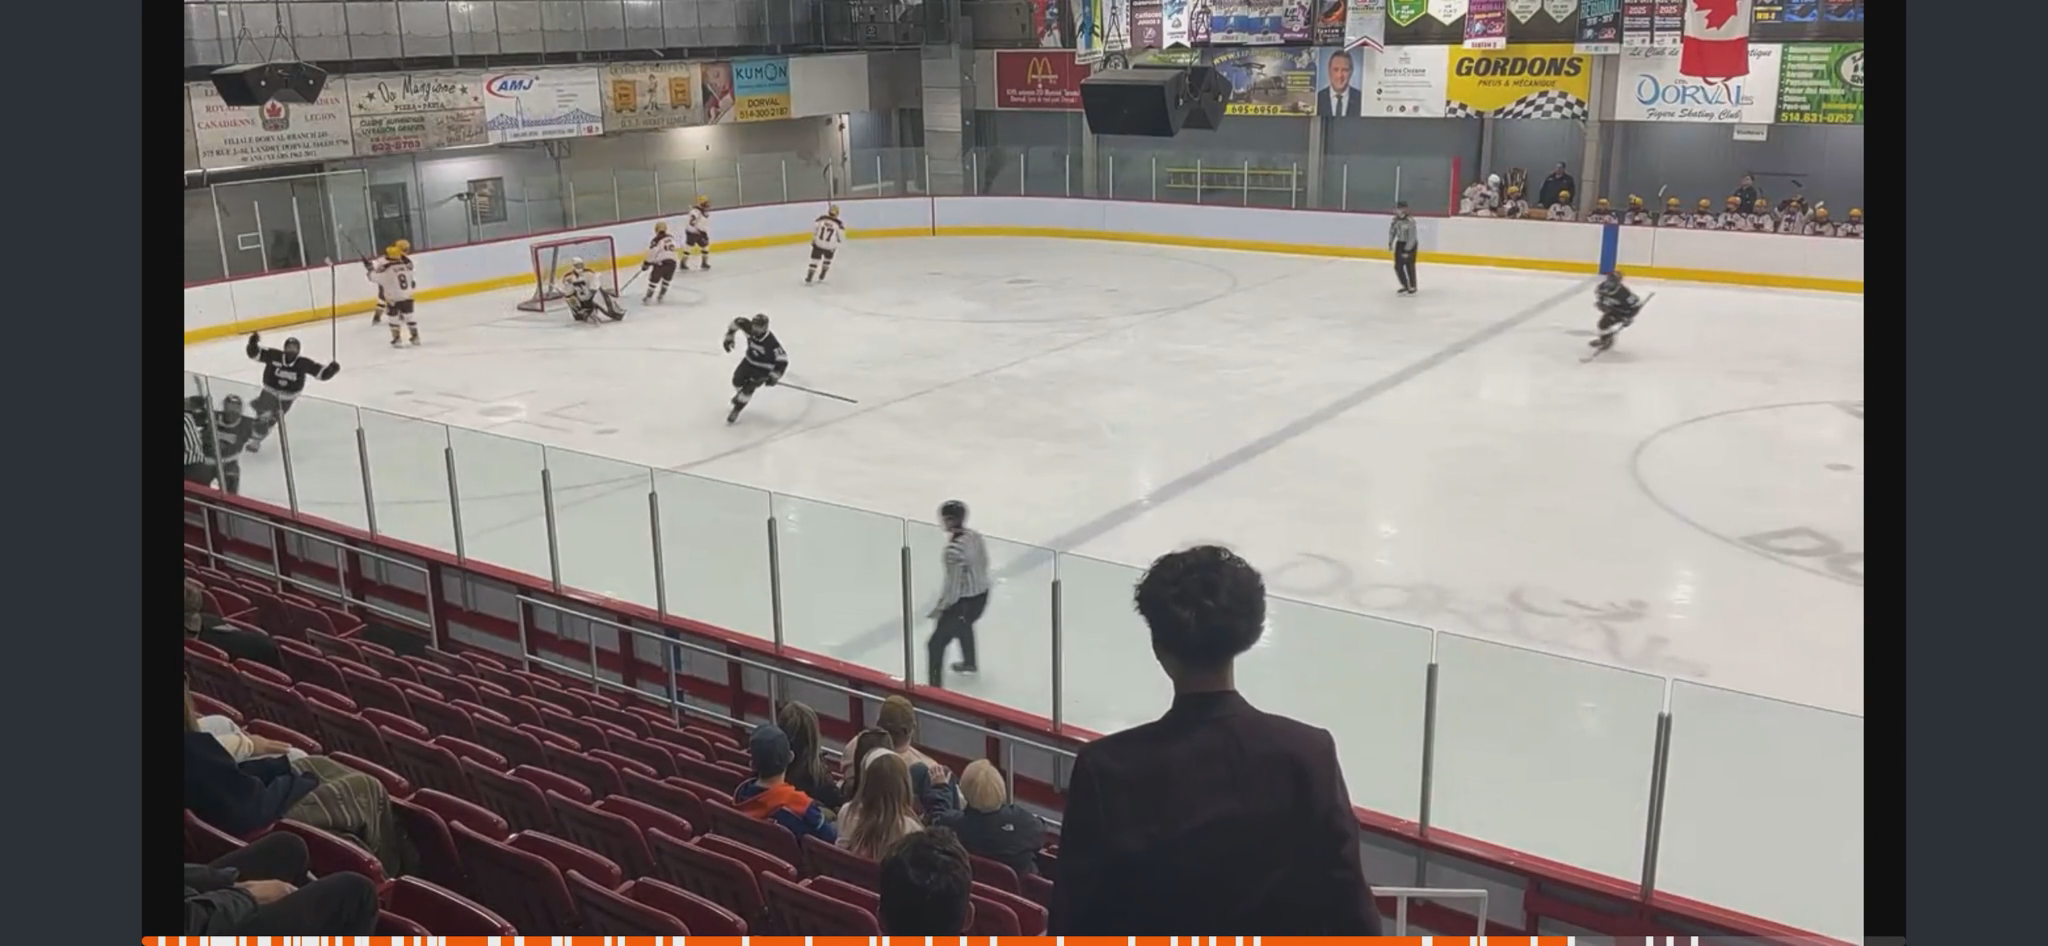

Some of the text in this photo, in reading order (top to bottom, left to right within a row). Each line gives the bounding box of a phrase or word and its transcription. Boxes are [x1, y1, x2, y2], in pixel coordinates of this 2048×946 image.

[736, 62, 788, 81] KUMON
[1455, 56, 1584, 77] GORDONS
[497, 80, 534, 91] AMJ
[1477, 80, 1502, 88] PNEUS
[1512, 79, 1557, 88] MÉCANIQUE
[1636, 74, 1742, 106] DORVAL
[747, 98, 780, 107] DORVAL
[1645, 108, 1741, 121] Figure Skating Club
[819, 226, 834, 242] 17
[398, 273, 409, 290] 8
